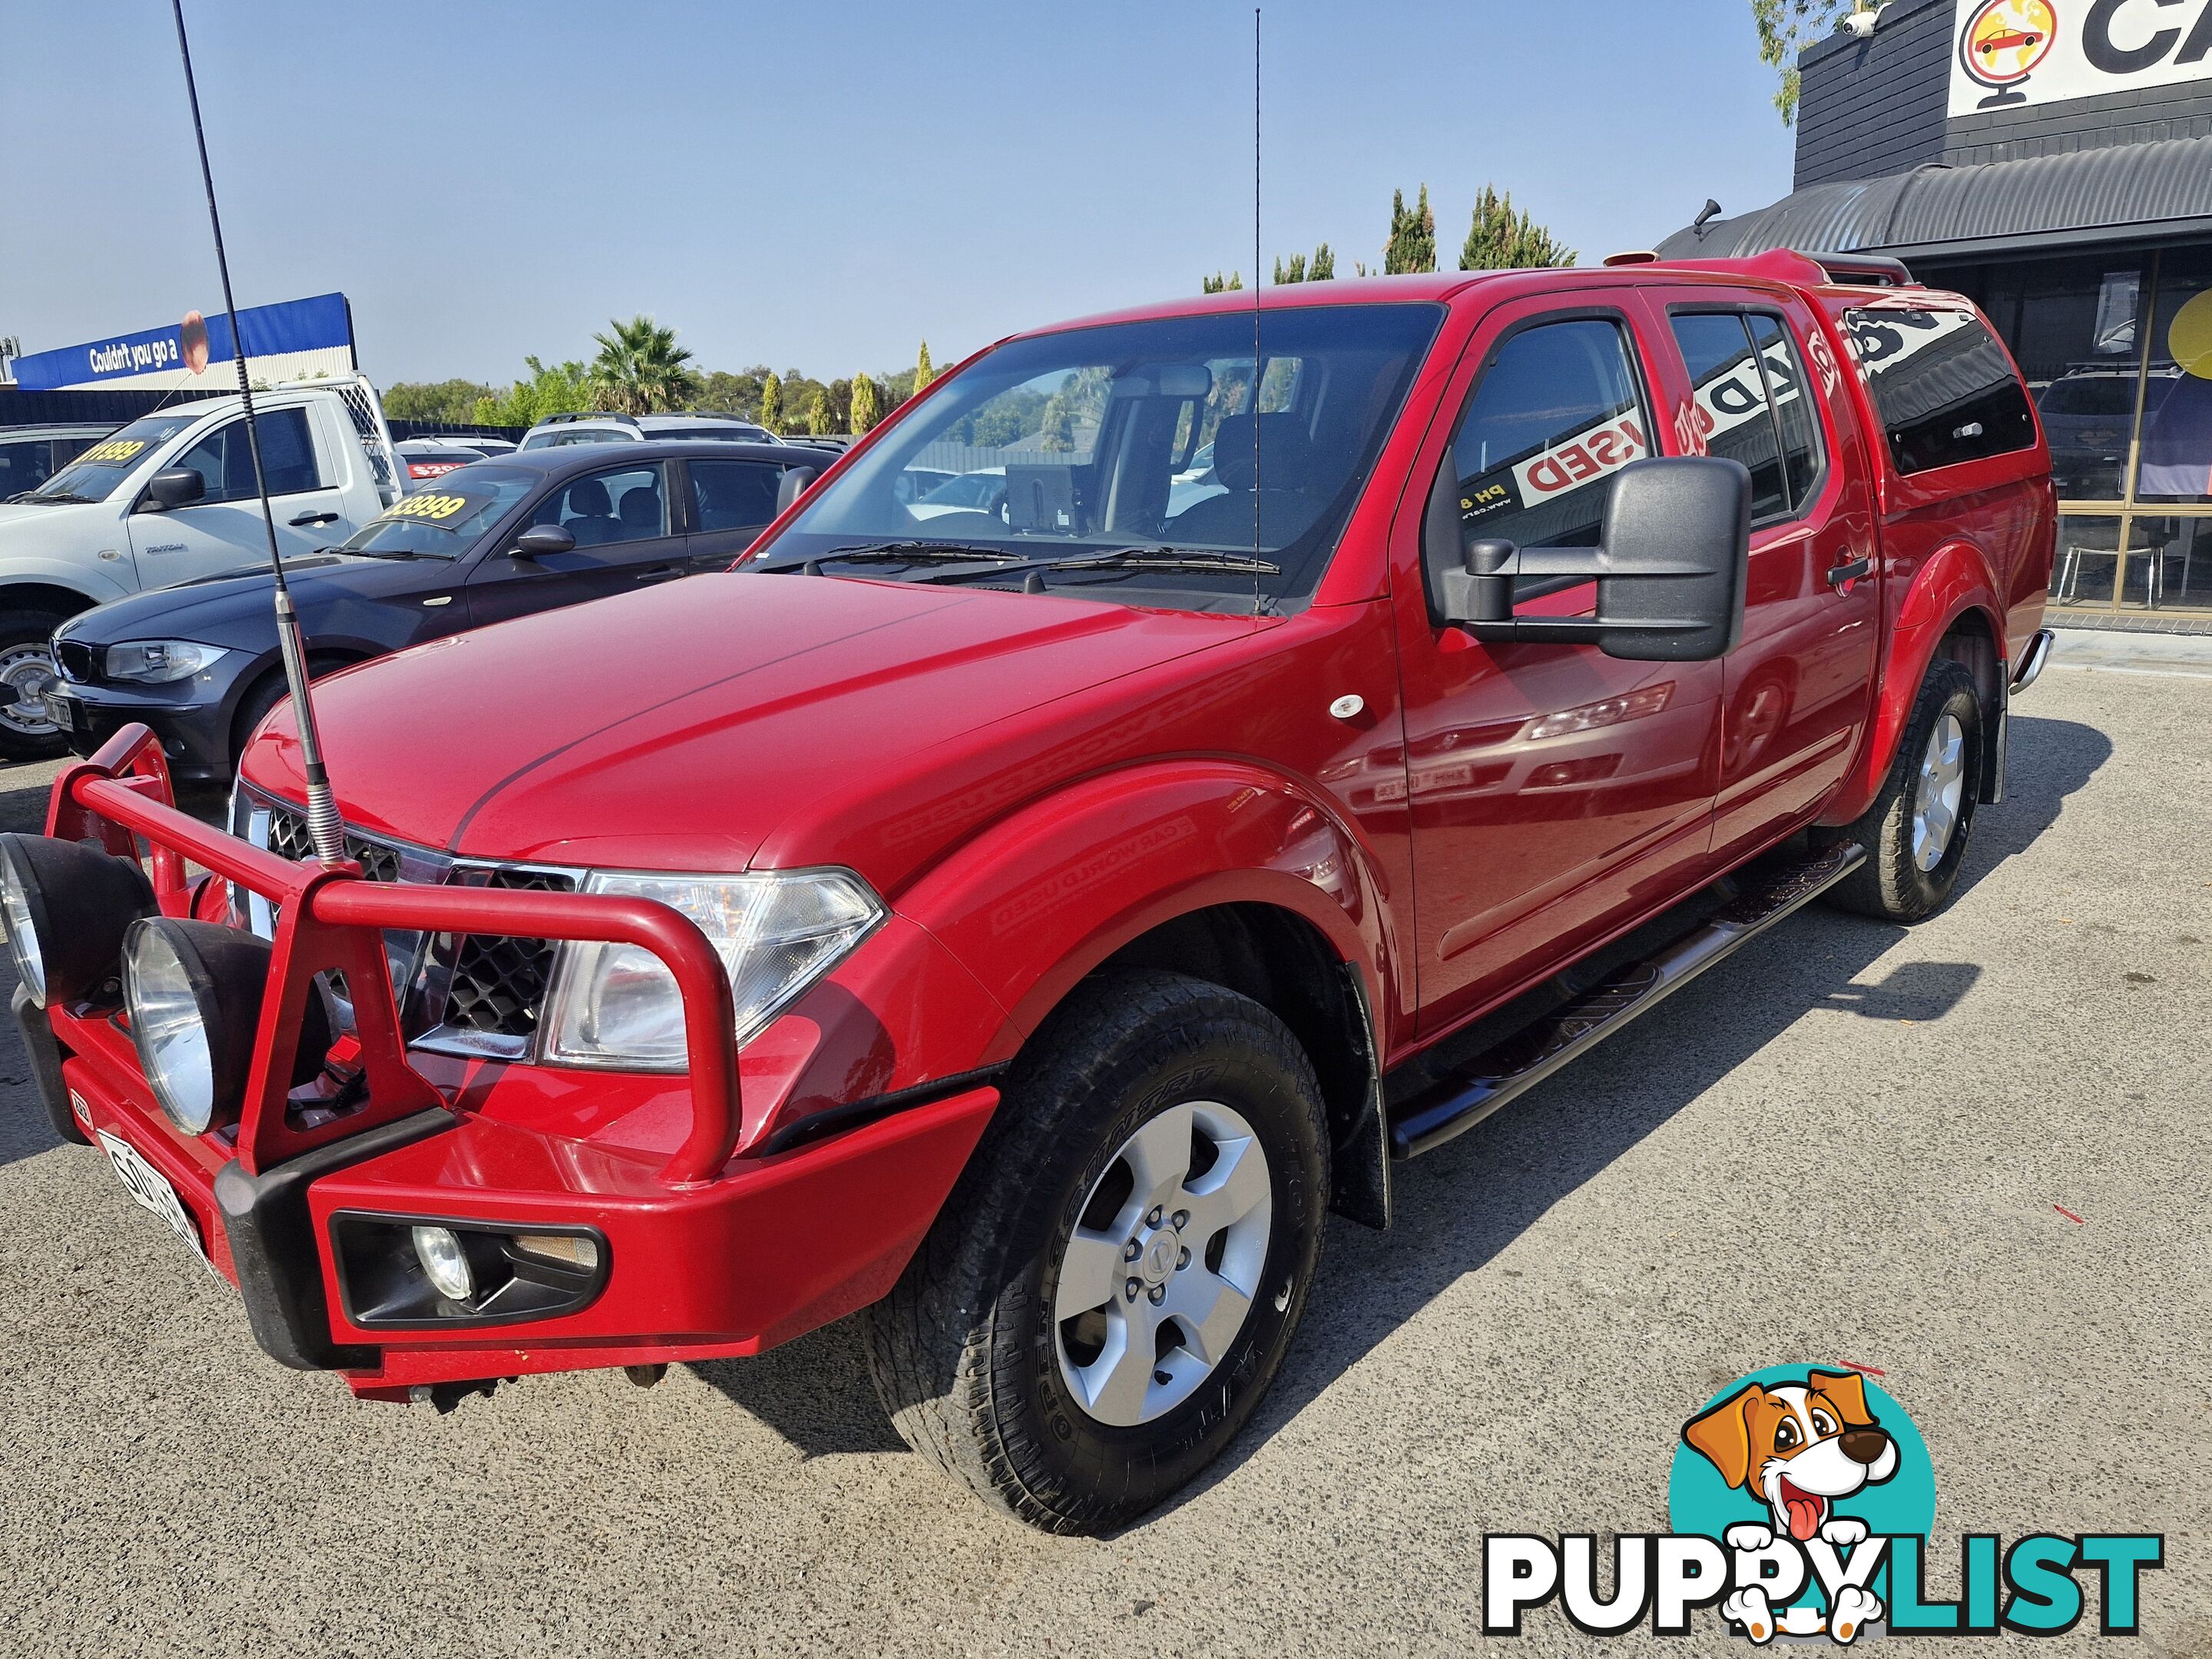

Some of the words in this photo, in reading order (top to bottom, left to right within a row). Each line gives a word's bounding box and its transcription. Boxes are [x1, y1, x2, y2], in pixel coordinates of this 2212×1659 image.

[90, 343, 131, 373] Couldn't
[131, 343, 152, 371] you
[152, 341, 167, 368] go
[169, 339, 178, 359] a
[412, 465, 461, 475] $29
